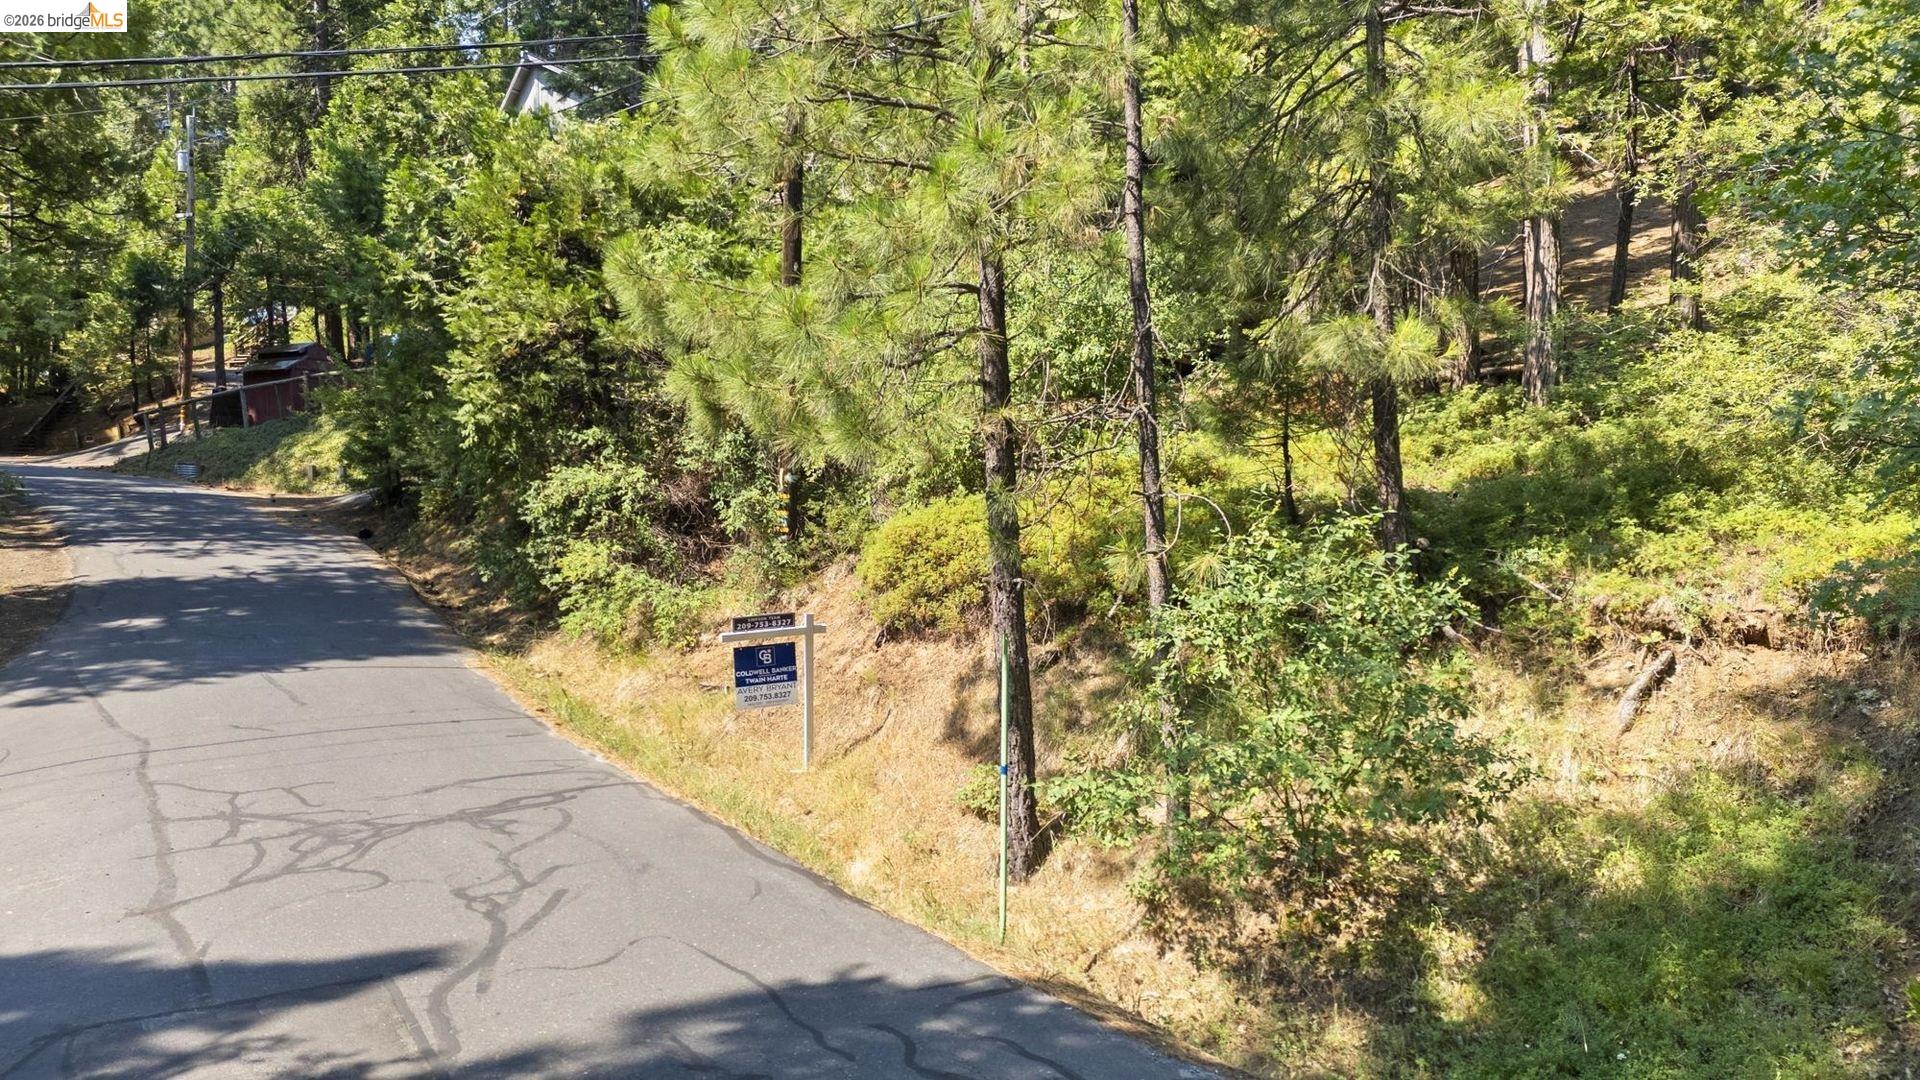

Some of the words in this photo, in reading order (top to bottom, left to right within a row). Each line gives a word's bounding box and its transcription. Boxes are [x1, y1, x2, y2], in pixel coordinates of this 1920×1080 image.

[736, 619, 791, 630] 209-753-8327
[735, 668, 770, 678] COLDWELL
[771, 665, 797, 674] BANKER
[767, 674, 788, 682] HARTE
[736, 685, 763, 695] AVERY
[767, 682, 796, 692] BRYANT
[744, 691, 791, 703] 209.753.8327
